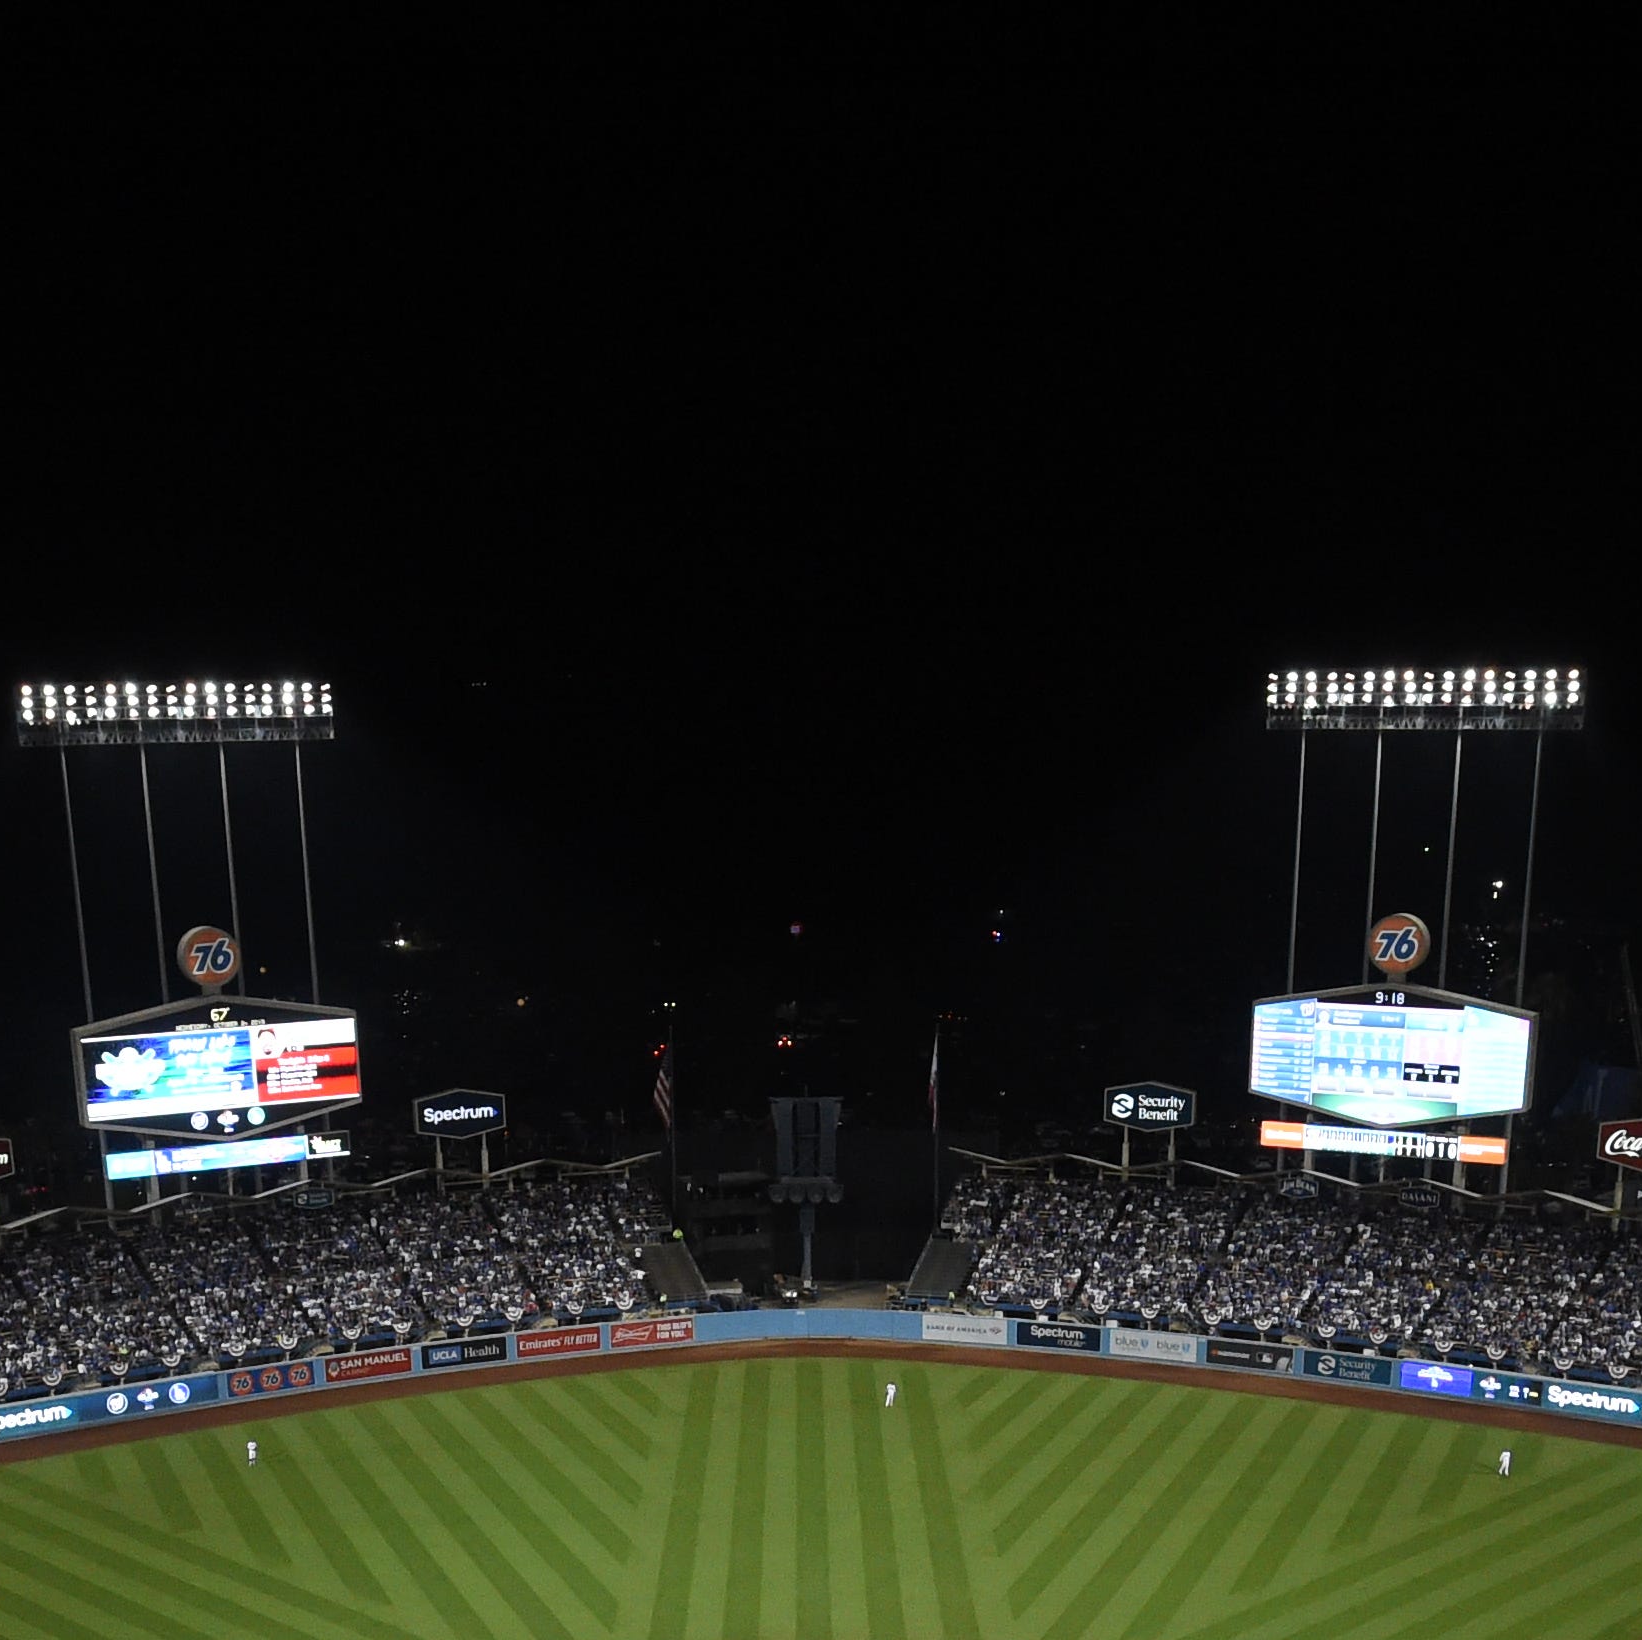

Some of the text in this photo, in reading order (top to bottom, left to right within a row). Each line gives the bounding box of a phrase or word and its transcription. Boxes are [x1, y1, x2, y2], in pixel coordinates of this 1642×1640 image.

[1375, 926, 1419, 963] 76
[190, 937, 235, 975] 76
[1375, 991, 1405, 1005] 9:18
[1138, 1094, 1186, 1111] Security
[423, 1106, 494, 1125] Spectrum
[1138, 1107, 1178, 1122] Benefit
[1030, 1325, 1085, 1340] Spectrum
[519, 1333, 599, 1351] Emirates FLY BETTER
[1115, 1336, 1139, 1347] blue
[1156, 1340, 1181, 1352] blue
[340, 1352, 409, 1370] SAN MANUEL
[432, 1345, 501, 1361] UCLA Health
[1338, 1357, 1378, 1371] Security
[236, 1370, 307, 1391] 76 76 76
[1338, 1368, 1371, 1381] Benefit
[1548, 1385, 1635, 1413] Spectrum
